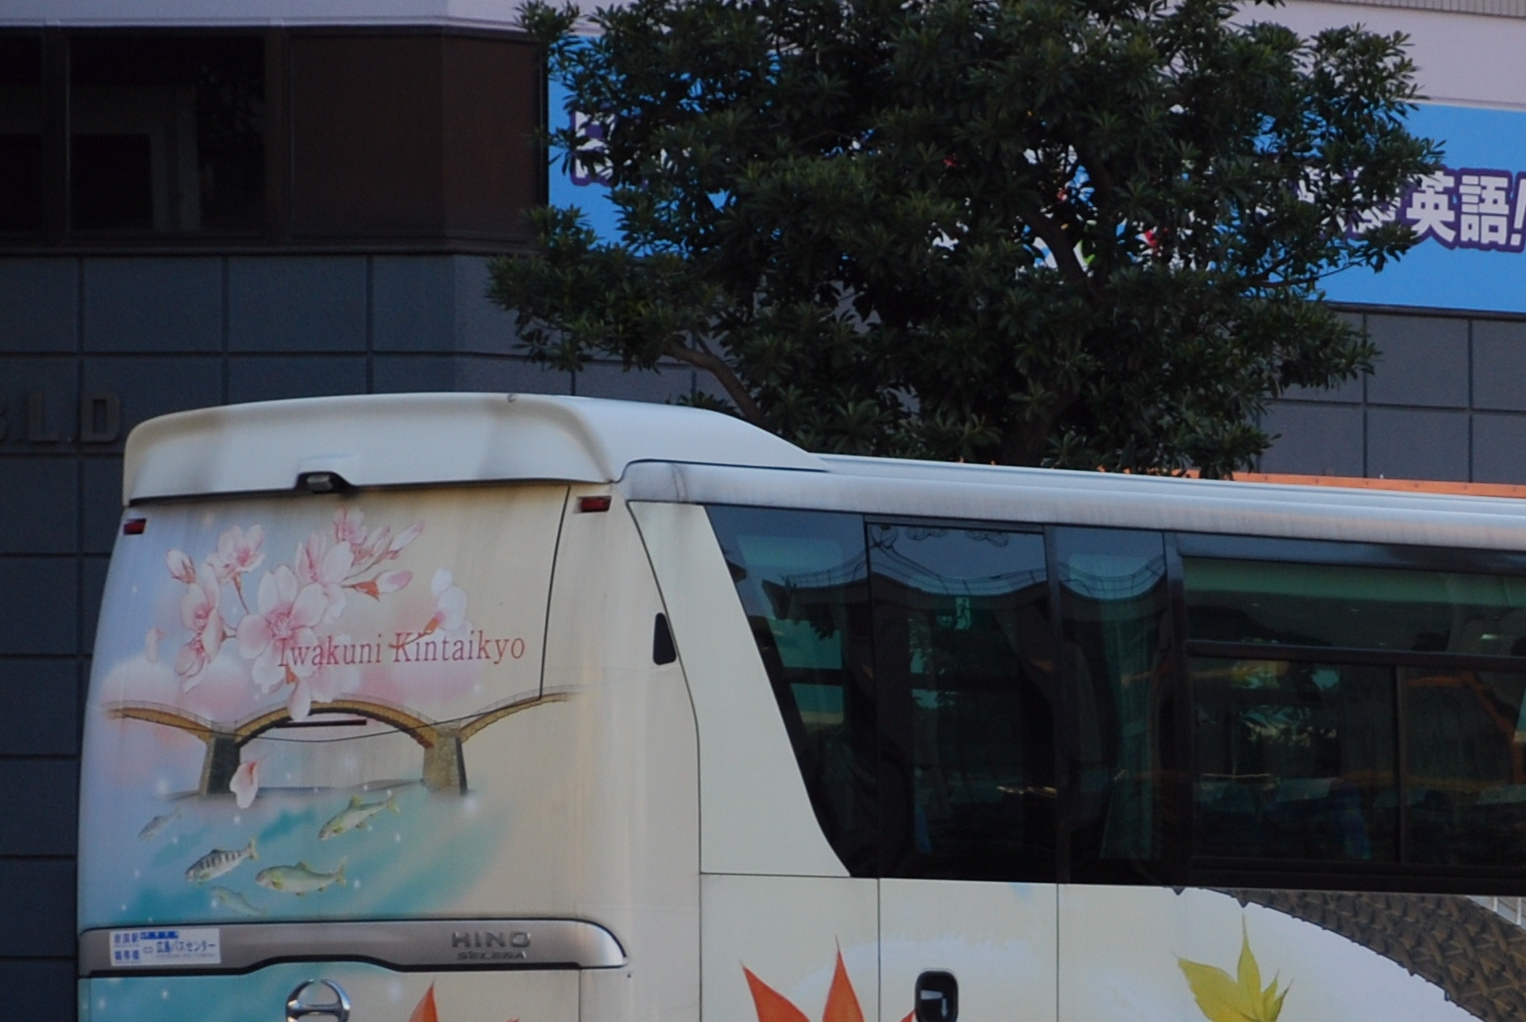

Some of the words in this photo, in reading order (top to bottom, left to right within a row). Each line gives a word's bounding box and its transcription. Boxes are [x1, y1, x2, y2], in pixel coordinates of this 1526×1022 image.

[278, 633, 382, 668] Iwakuni
[392, 629, 526, 668] Kintaikyo
[451, 930, 532, 948] HINO
